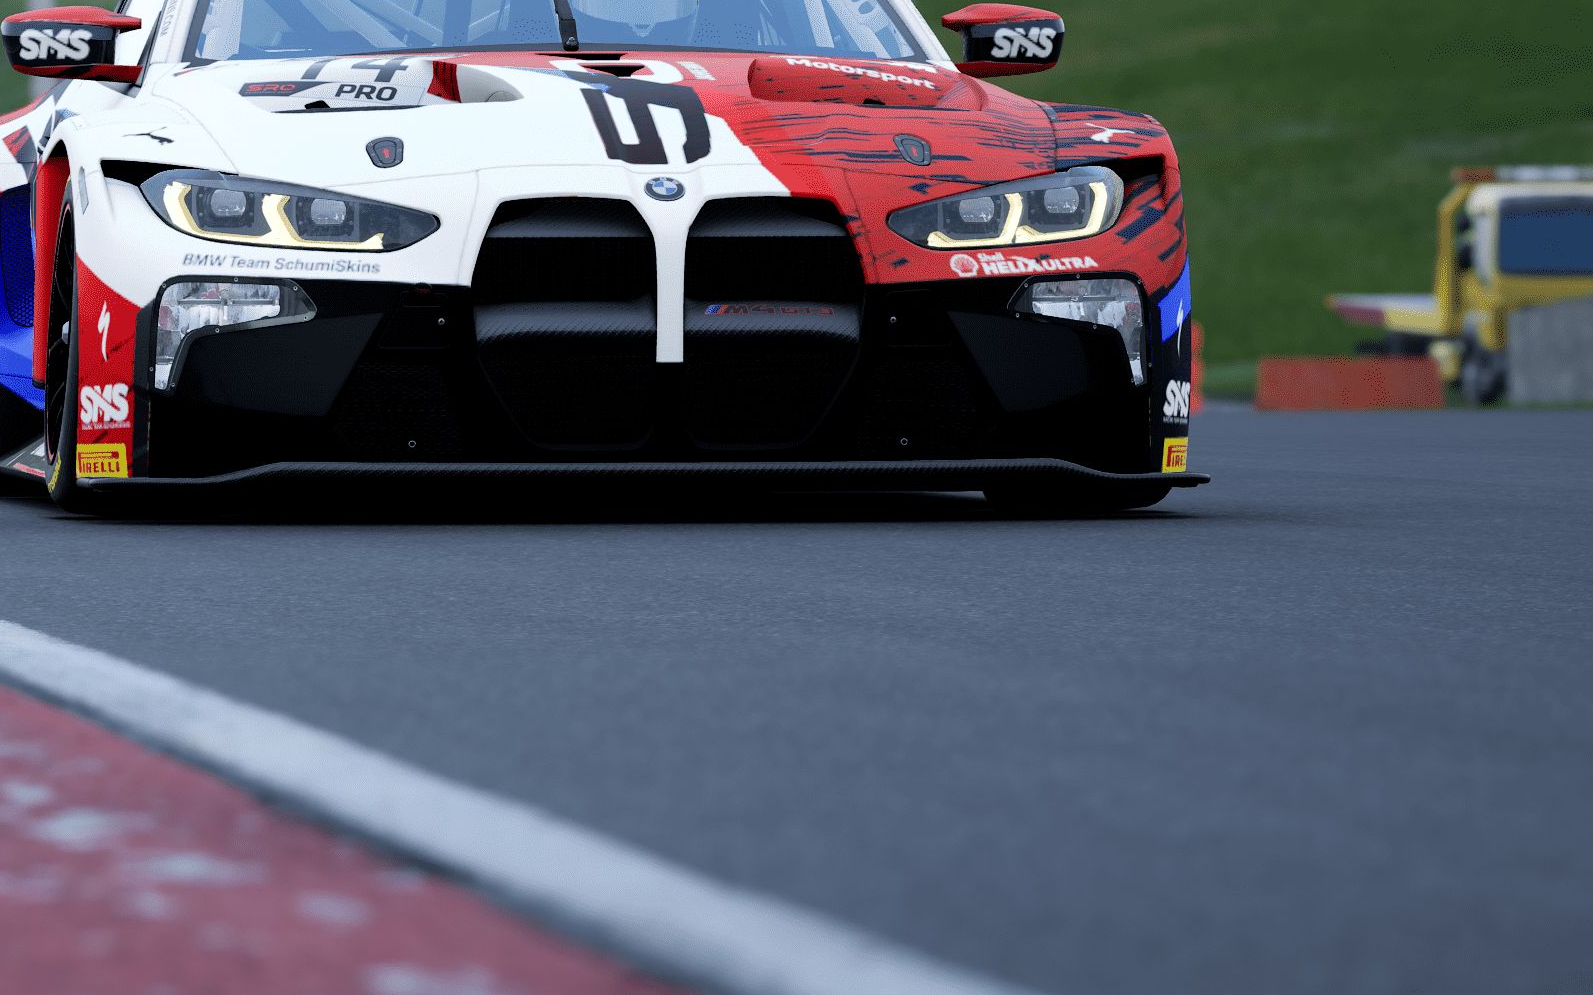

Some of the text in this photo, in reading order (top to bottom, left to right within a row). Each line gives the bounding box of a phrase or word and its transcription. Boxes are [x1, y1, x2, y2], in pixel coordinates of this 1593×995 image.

[19, 28, 93, 61] SMS
[991, 26, 1057, 58] SMS
[786, 58, 937, 90] Motorsport
[334, 83, 398, 102] PRO
[182, 253, 381, 274] BMW Team SchumiSkins
[1040, 255, 1098, 272] ULTRA
[80, 381, 129, 424] SMS
[78, 451, 120, 474] PIRELLI
